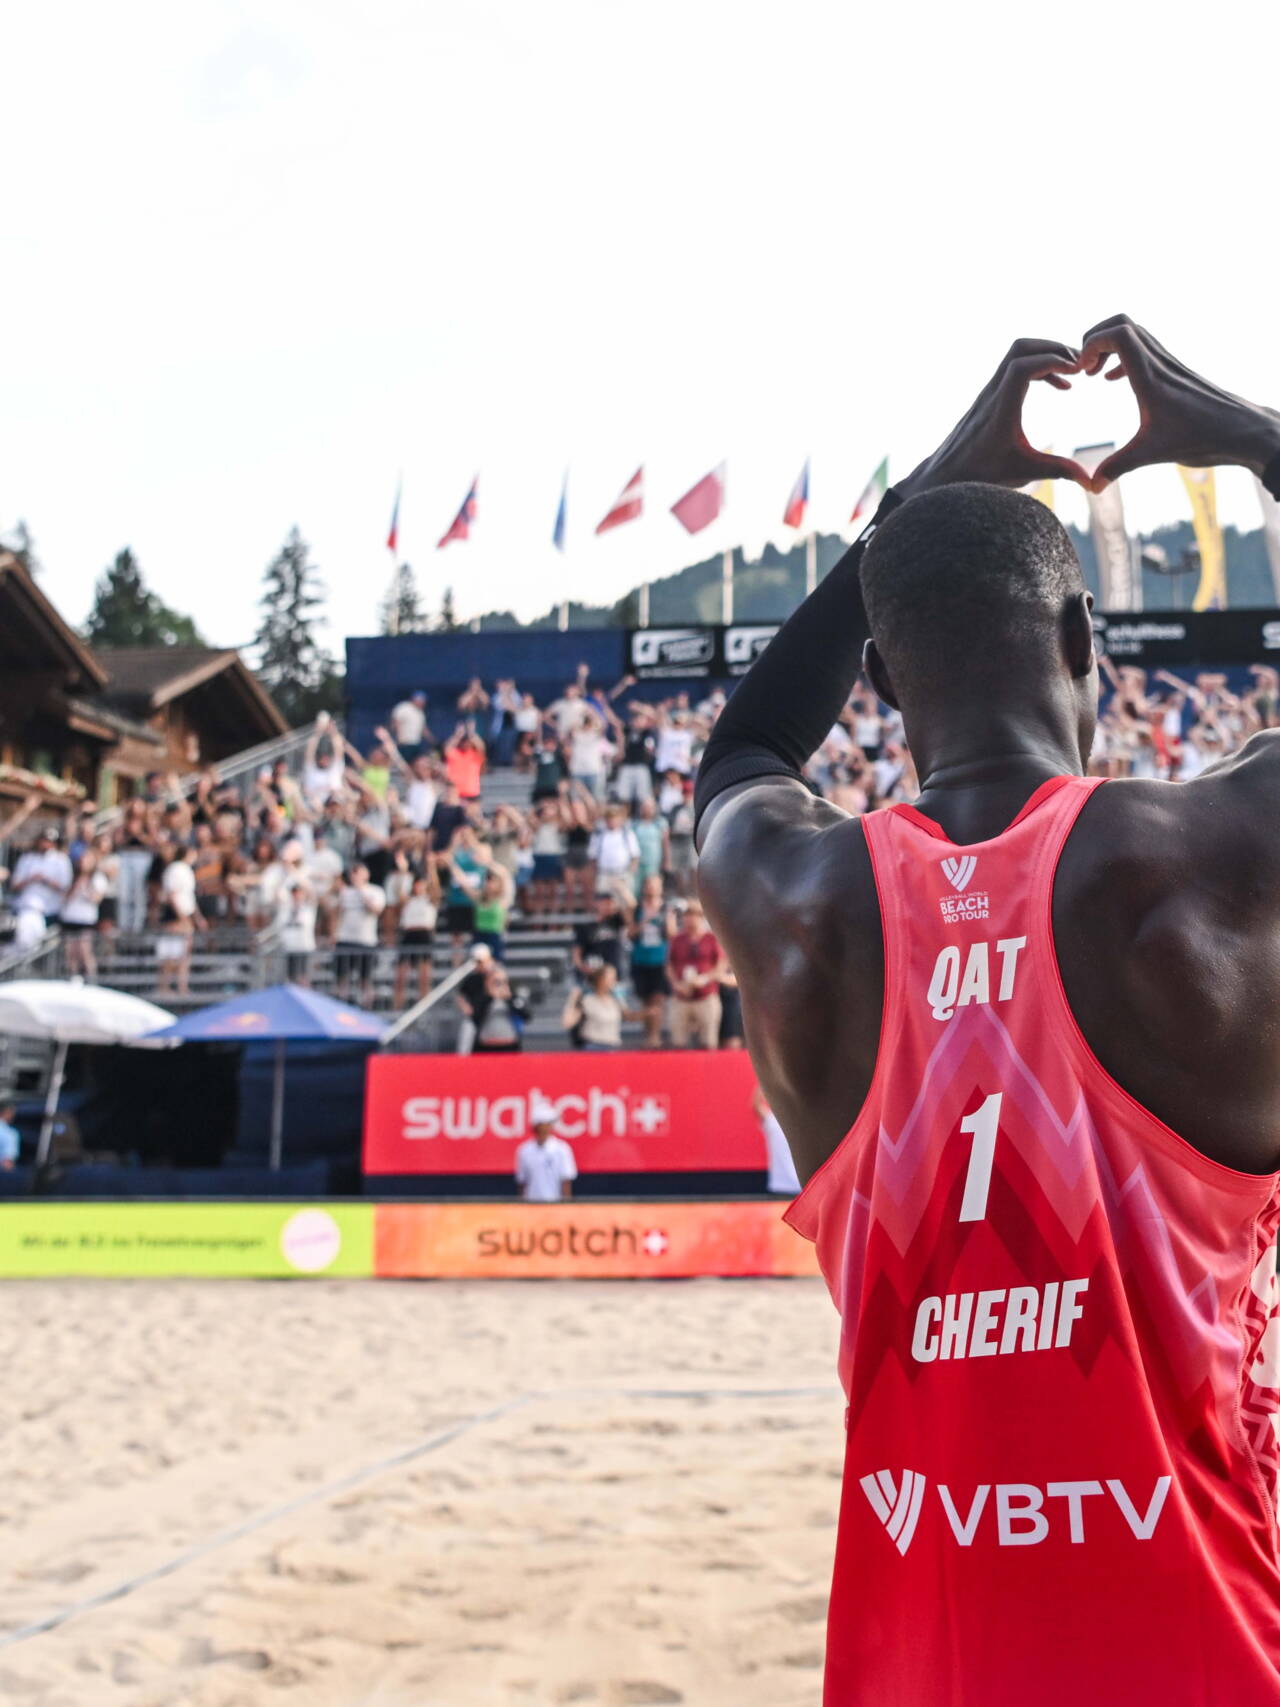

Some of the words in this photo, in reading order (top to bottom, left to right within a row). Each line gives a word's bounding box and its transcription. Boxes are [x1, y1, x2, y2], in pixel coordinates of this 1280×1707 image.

[940, 896, 989, 915] BEACH
[944, 914, 960, 924] PRO
[960, 910, 989, 920] TOUR
[927, 935, 1027, 1021] QAT
[958, 1091, 1003, 1223] 1
[477, 1225, 637, 1257] swatch
[911, 1278, 1090, 1363] CHERIF
[937, 1475, 1172, 1546] VBTV
